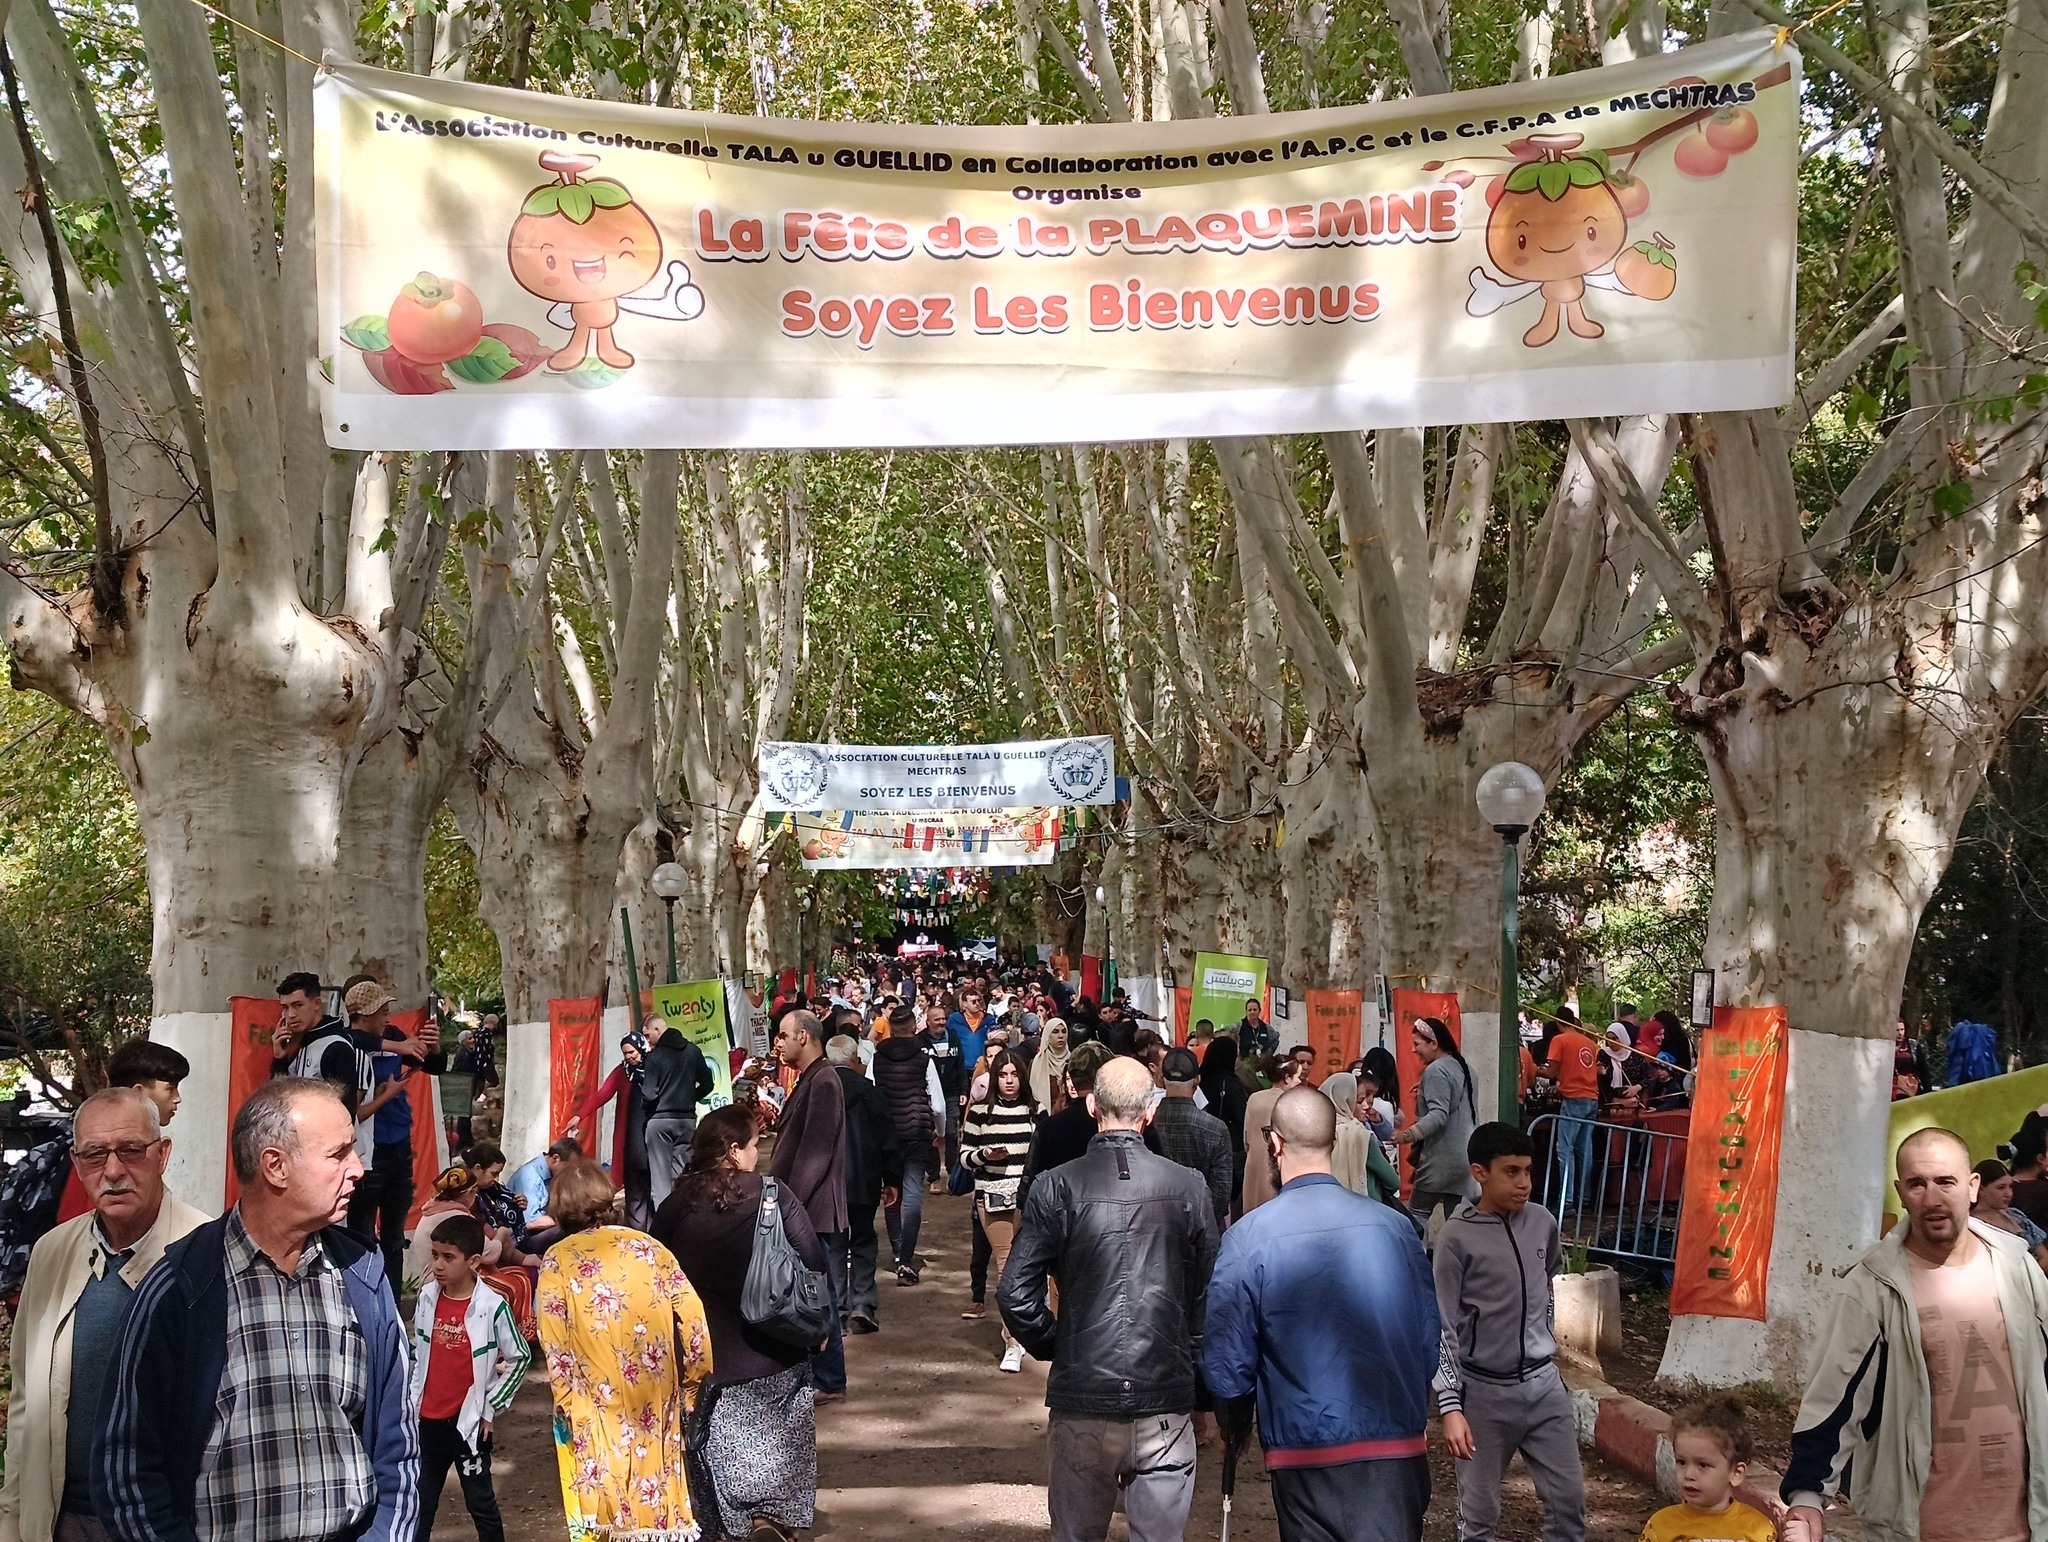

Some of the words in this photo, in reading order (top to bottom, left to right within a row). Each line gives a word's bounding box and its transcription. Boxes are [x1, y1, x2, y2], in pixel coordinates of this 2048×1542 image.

[577, 130, 719, 157] Culturelle
[727, 144, 799, 164] TALA
[807, 152, 825, 165] u
[834, 149, 950, 172] GUELLID
[961, 157, 996, 173] en
[1005, 153, 1198, 174] Collaboration
[1206, 147, 1273, 167] avec
[1383, 130, 1412, 148] et
[1421, 122, 1448, 144] le
[1456, 111, 1556, 138] C.F.P.A
[1564, 104, 1601, 121] de
[1609, 82, 1756, 113] MECHTRAS
[1012, 183, 1142, 205] Organise
[697, 207, 766, 255] La
[782, 211, 910, 254] Fête
[926, 216, 1000, 252] de
[1016, 216, 1072, 250] la
[1087, 189, 1460, 248] PLAQUEMINE
[781, 288, 955, 345] Soyez
[973, 285, 1069, 331] Les
[1088, 277, 1381, 328] Bienvenus
[828, 753, 898, 762] ASSOCIATION
[901, 753, 963, 761] CULTURELLE
[966, 752, 990, 760] TALA
[993, 752, 1001, 760] U
[1003, 750, 1047, 760] GUELLID
[907, 766, 967, 776] MECHTRAS
[860, 787, 904, 798] SOYEZ
[908, 786, 933, 797] LES
[937, 785, 1016, 797] BIENVENUS
